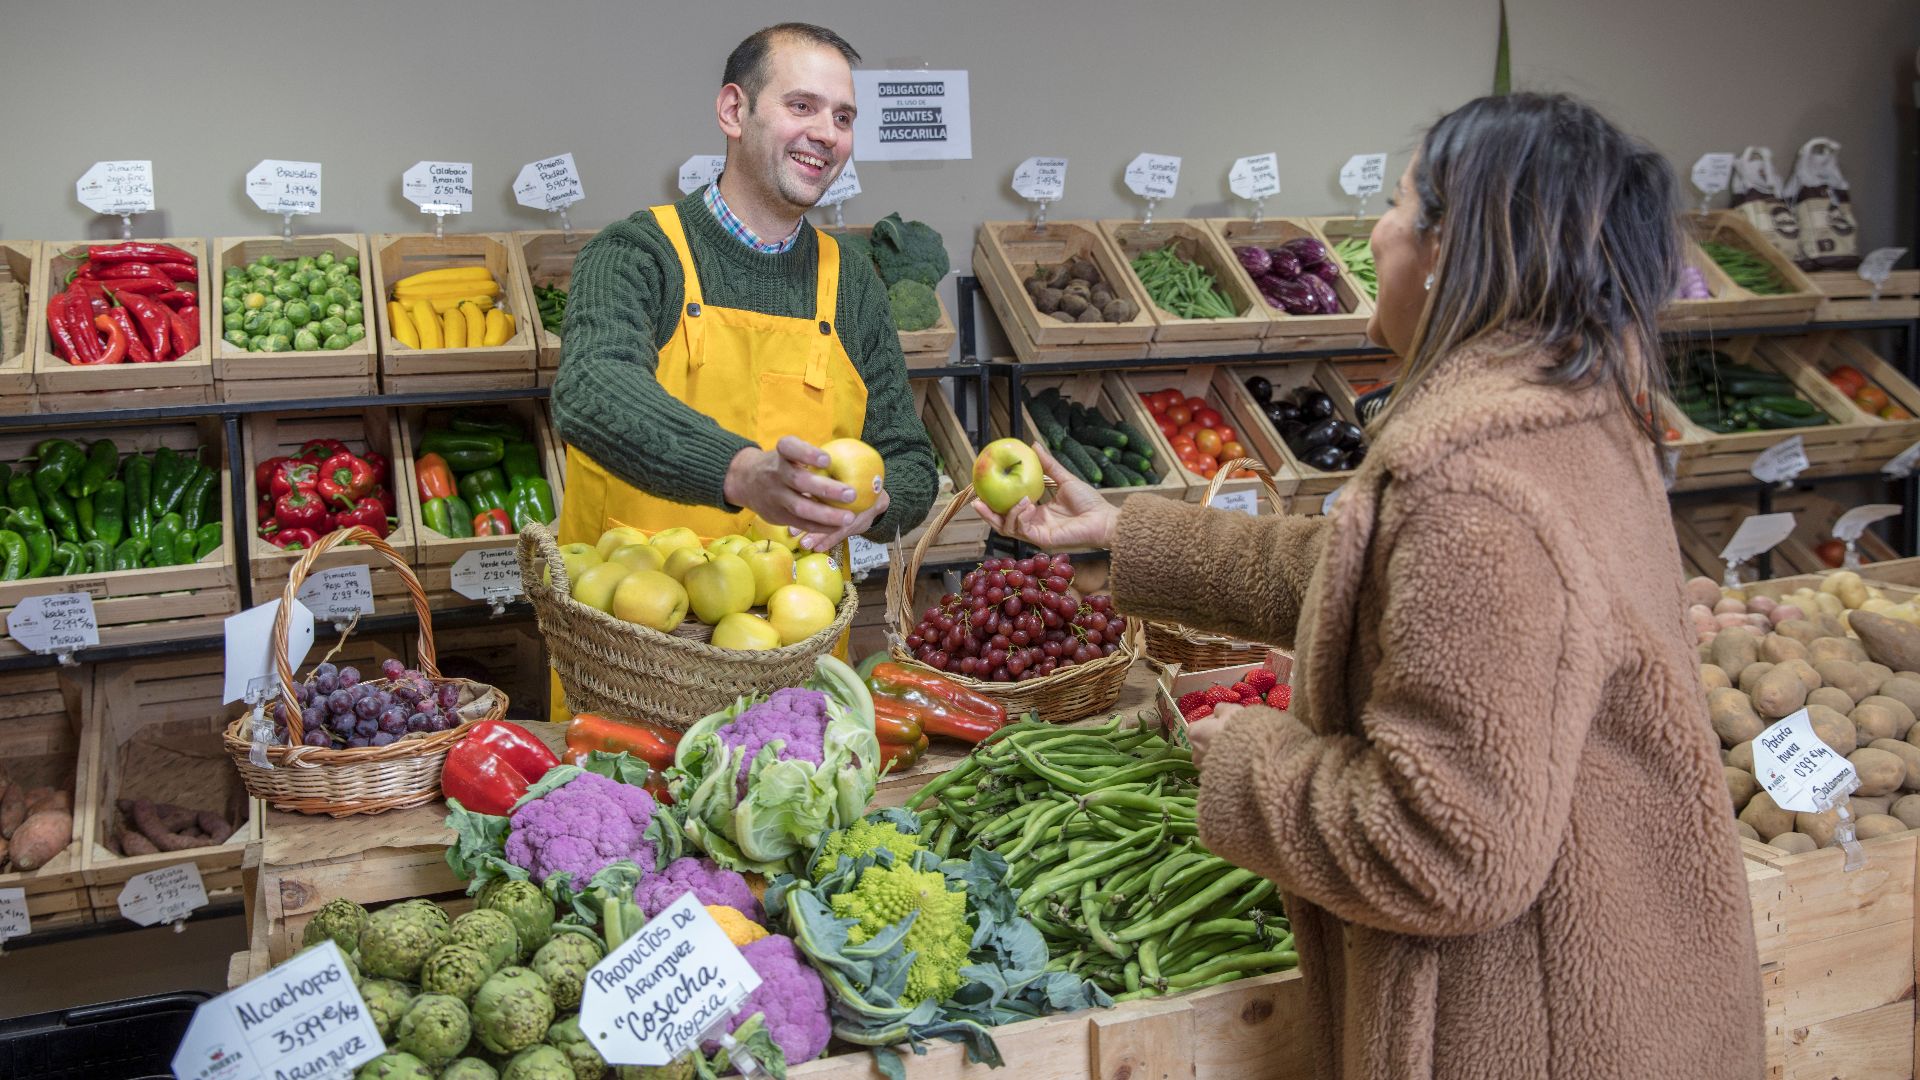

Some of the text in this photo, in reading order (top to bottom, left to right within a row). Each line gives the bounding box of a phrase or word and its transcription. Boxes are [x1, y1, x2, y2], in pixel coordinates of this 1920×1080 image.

[879, 84, 944, 96] OBLIGATORIO
[882, 110, 942, 124] GUANTES y
[880, 128, 947, 140] MASCARILLA
[1761, 726, 1793, 754] Patata
[235, 963, 342, 1031] Alcachofas
